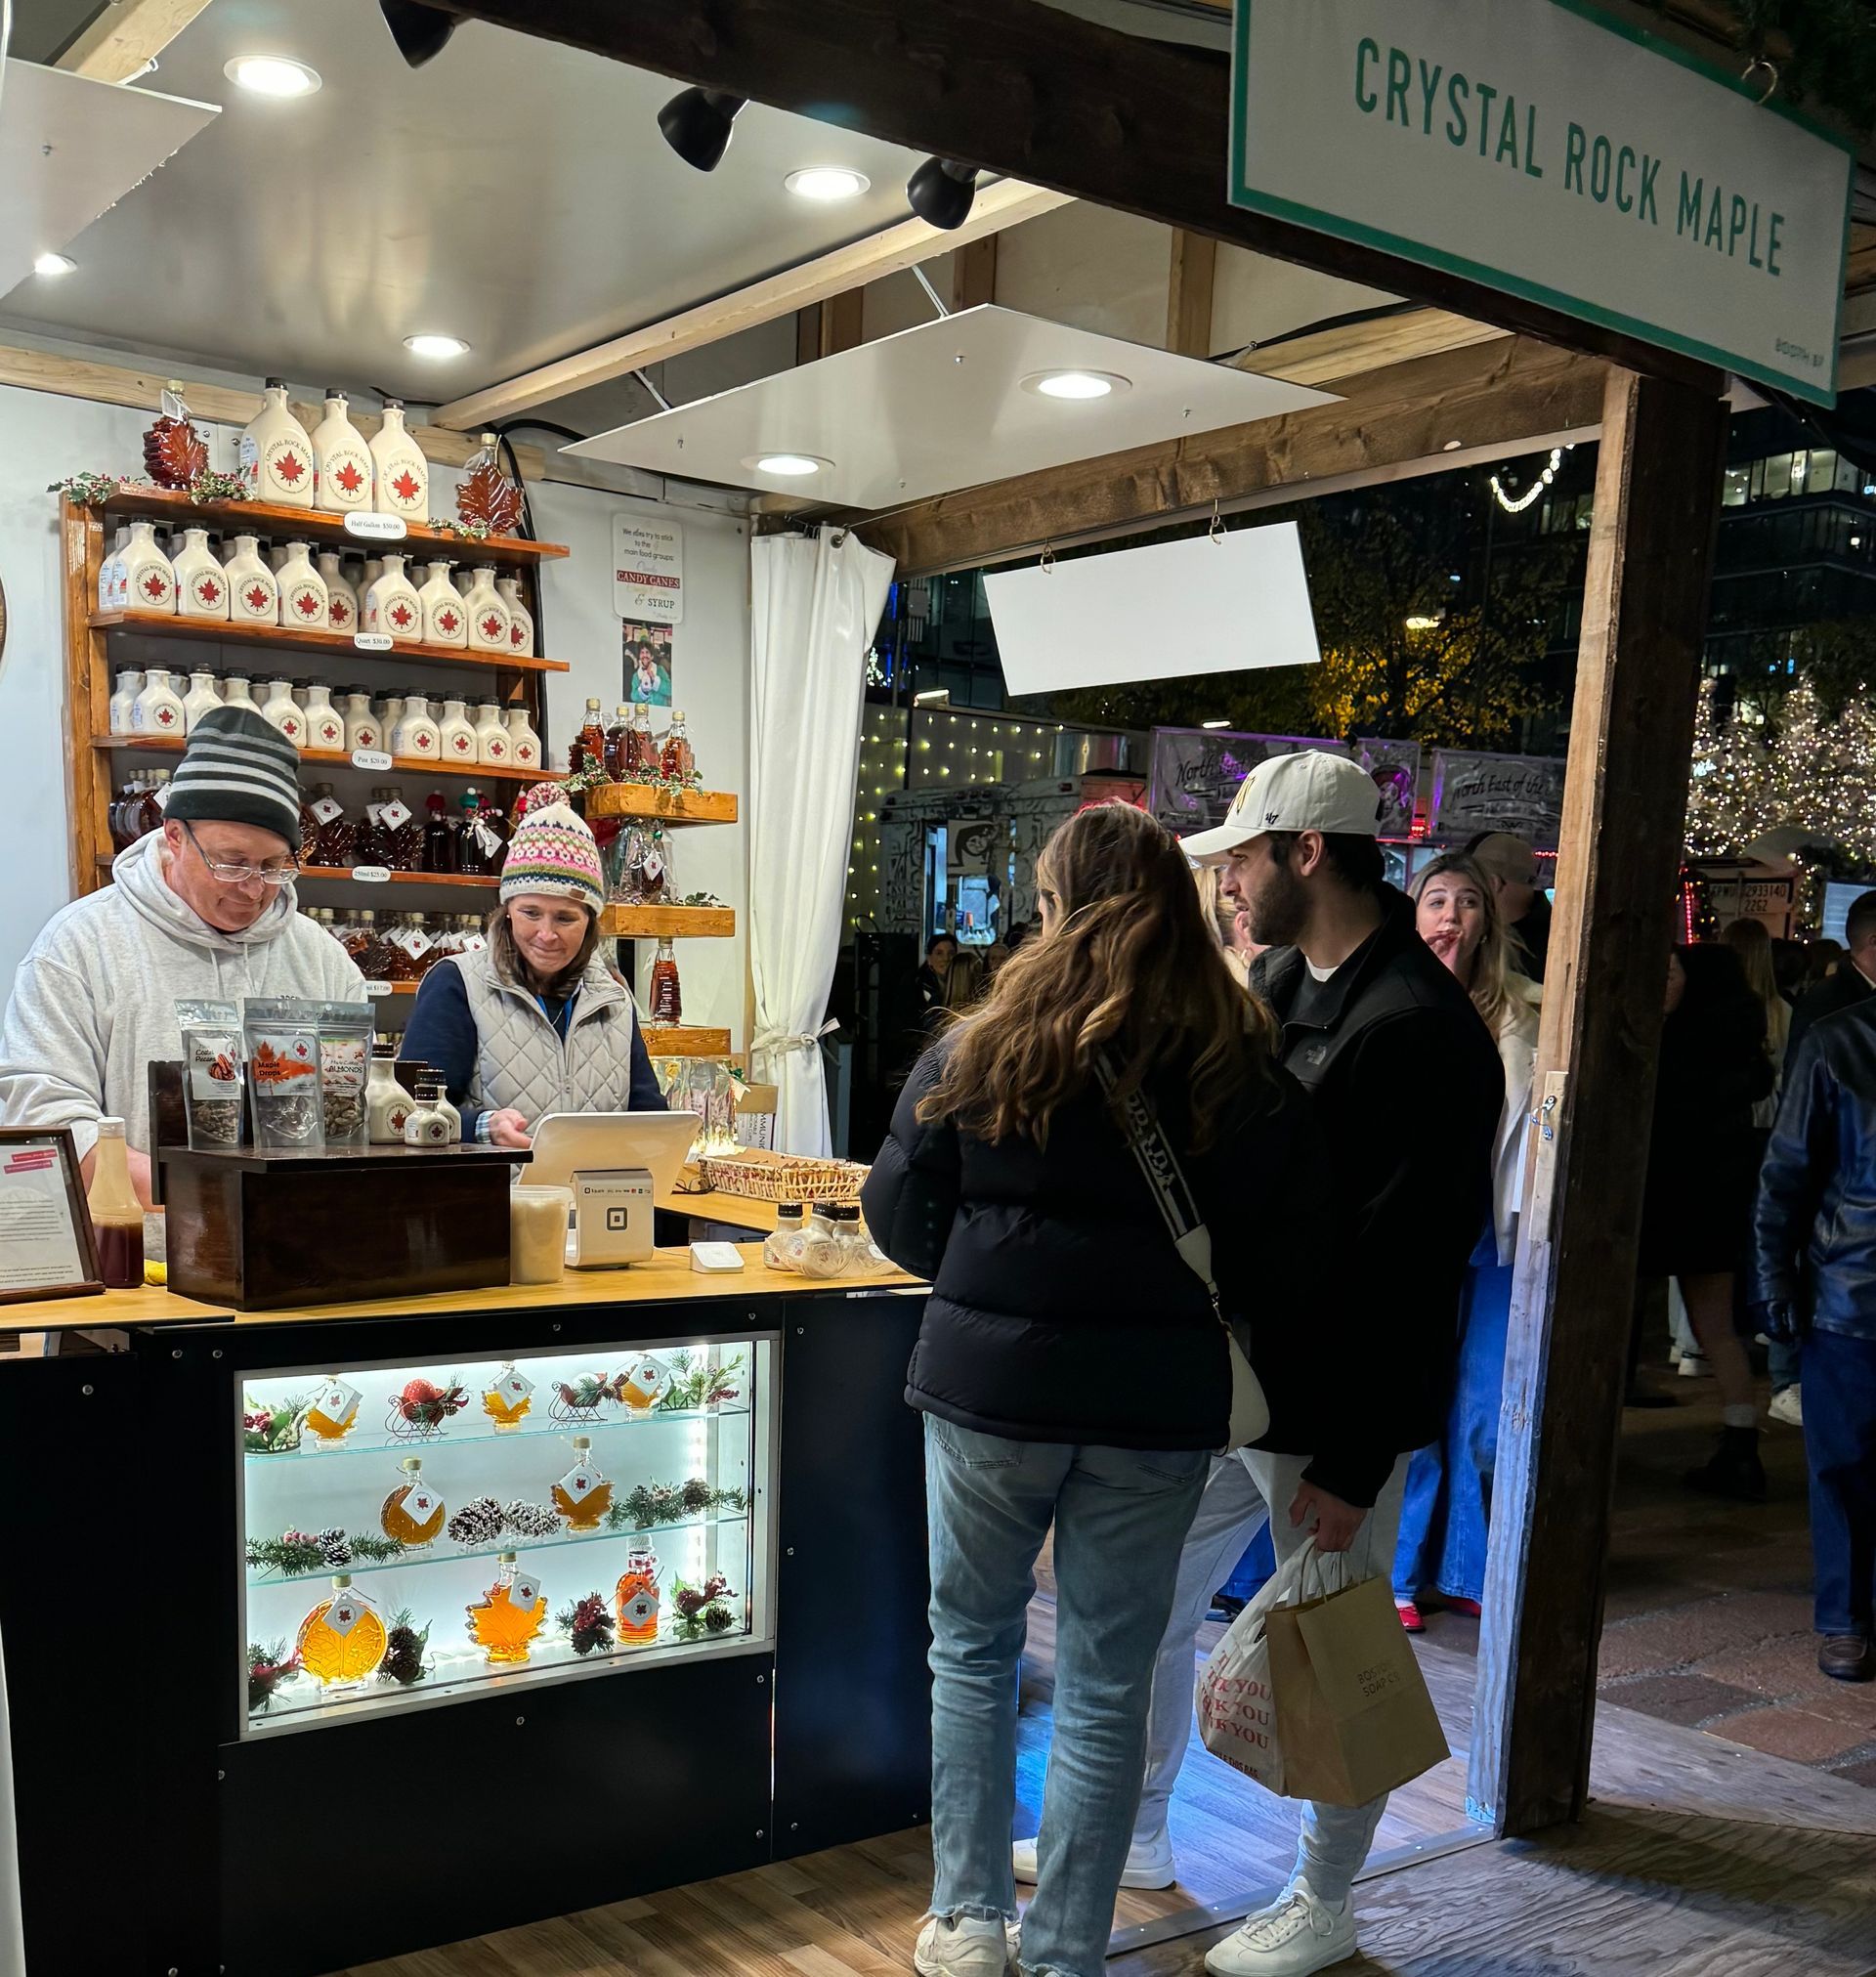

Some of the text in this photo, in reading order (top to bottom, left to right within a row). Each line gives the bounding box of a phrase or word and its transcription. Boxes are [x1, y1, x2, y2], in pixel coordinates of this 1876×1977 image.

[1355, 37, 1785, 276] CRYSTAL ROCK MAPLE
[266, 440, 284, 461] CRYSTAL
[284, 439, 299, 449] ROCK
[301, 447, 312, 468] MAPLE
[324, 451, 343, 472] CRYSTAL
[639, 549, 652, 558] food
[618, 572, 679, 588] CANDY CANES
[635, 594, 674, 609] & SYRUP
[1175, 754, 1215, 787] North
[1487, 775, 1512, 793] East
[1513, 773, 1525, 797] of
[1526, 776, 1544, 795] the
[1235, 1679, 1272, 1701] YOU
[1362, 1677, 1386, 1697] SOAP
[1230, 1722, 1269, 1749] YOU
